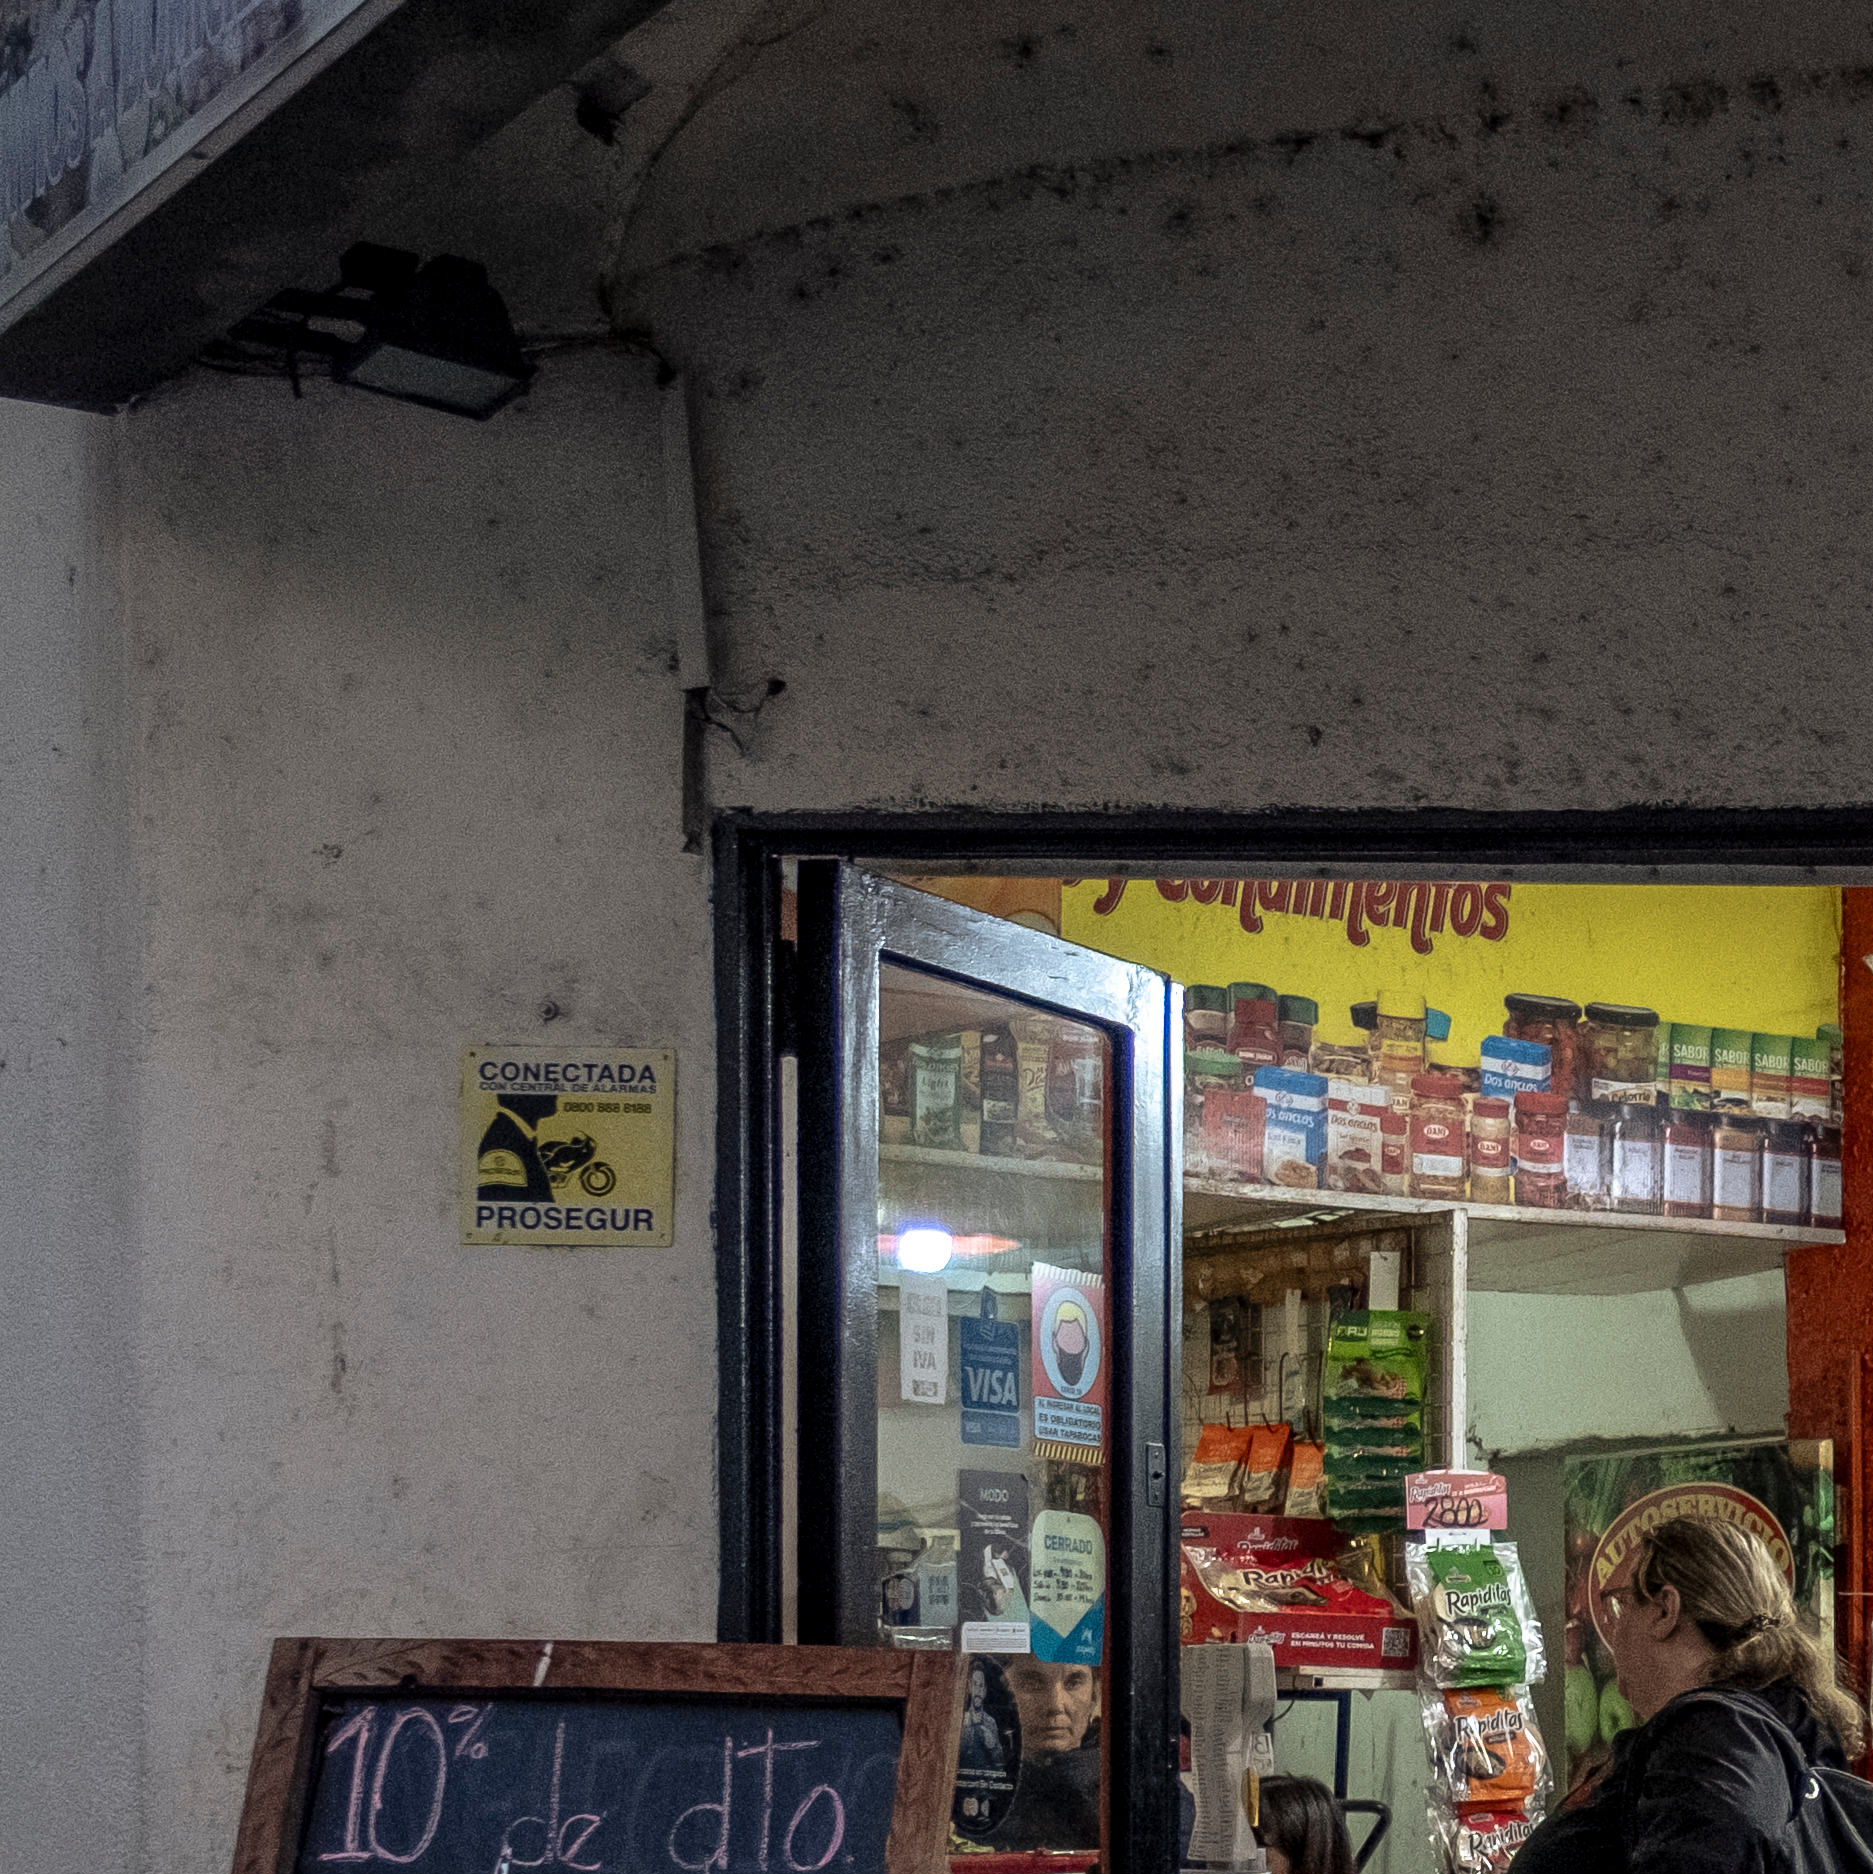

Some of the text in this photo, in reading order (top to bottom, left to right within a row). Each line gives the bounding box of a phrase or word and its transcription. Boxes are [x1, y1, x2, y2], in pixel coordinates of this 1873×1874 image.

[479, 1061, 656, 1083] CONECTADA
[1484, 1073, 1502, 1087] Dos
[480, 1082, 656, 1094] CON CENTRAL DE ALARMAS
[475, 1206, 654, 1231] PROSEGUR
[964, 1366, 1018, 1406] VISA
[1044, 1534, 1092, 1554] CERRADO
[1446, 1583, 1512, 1617] Rapiditas
[1455, 1709, 1525, 1739] Rapiditas
